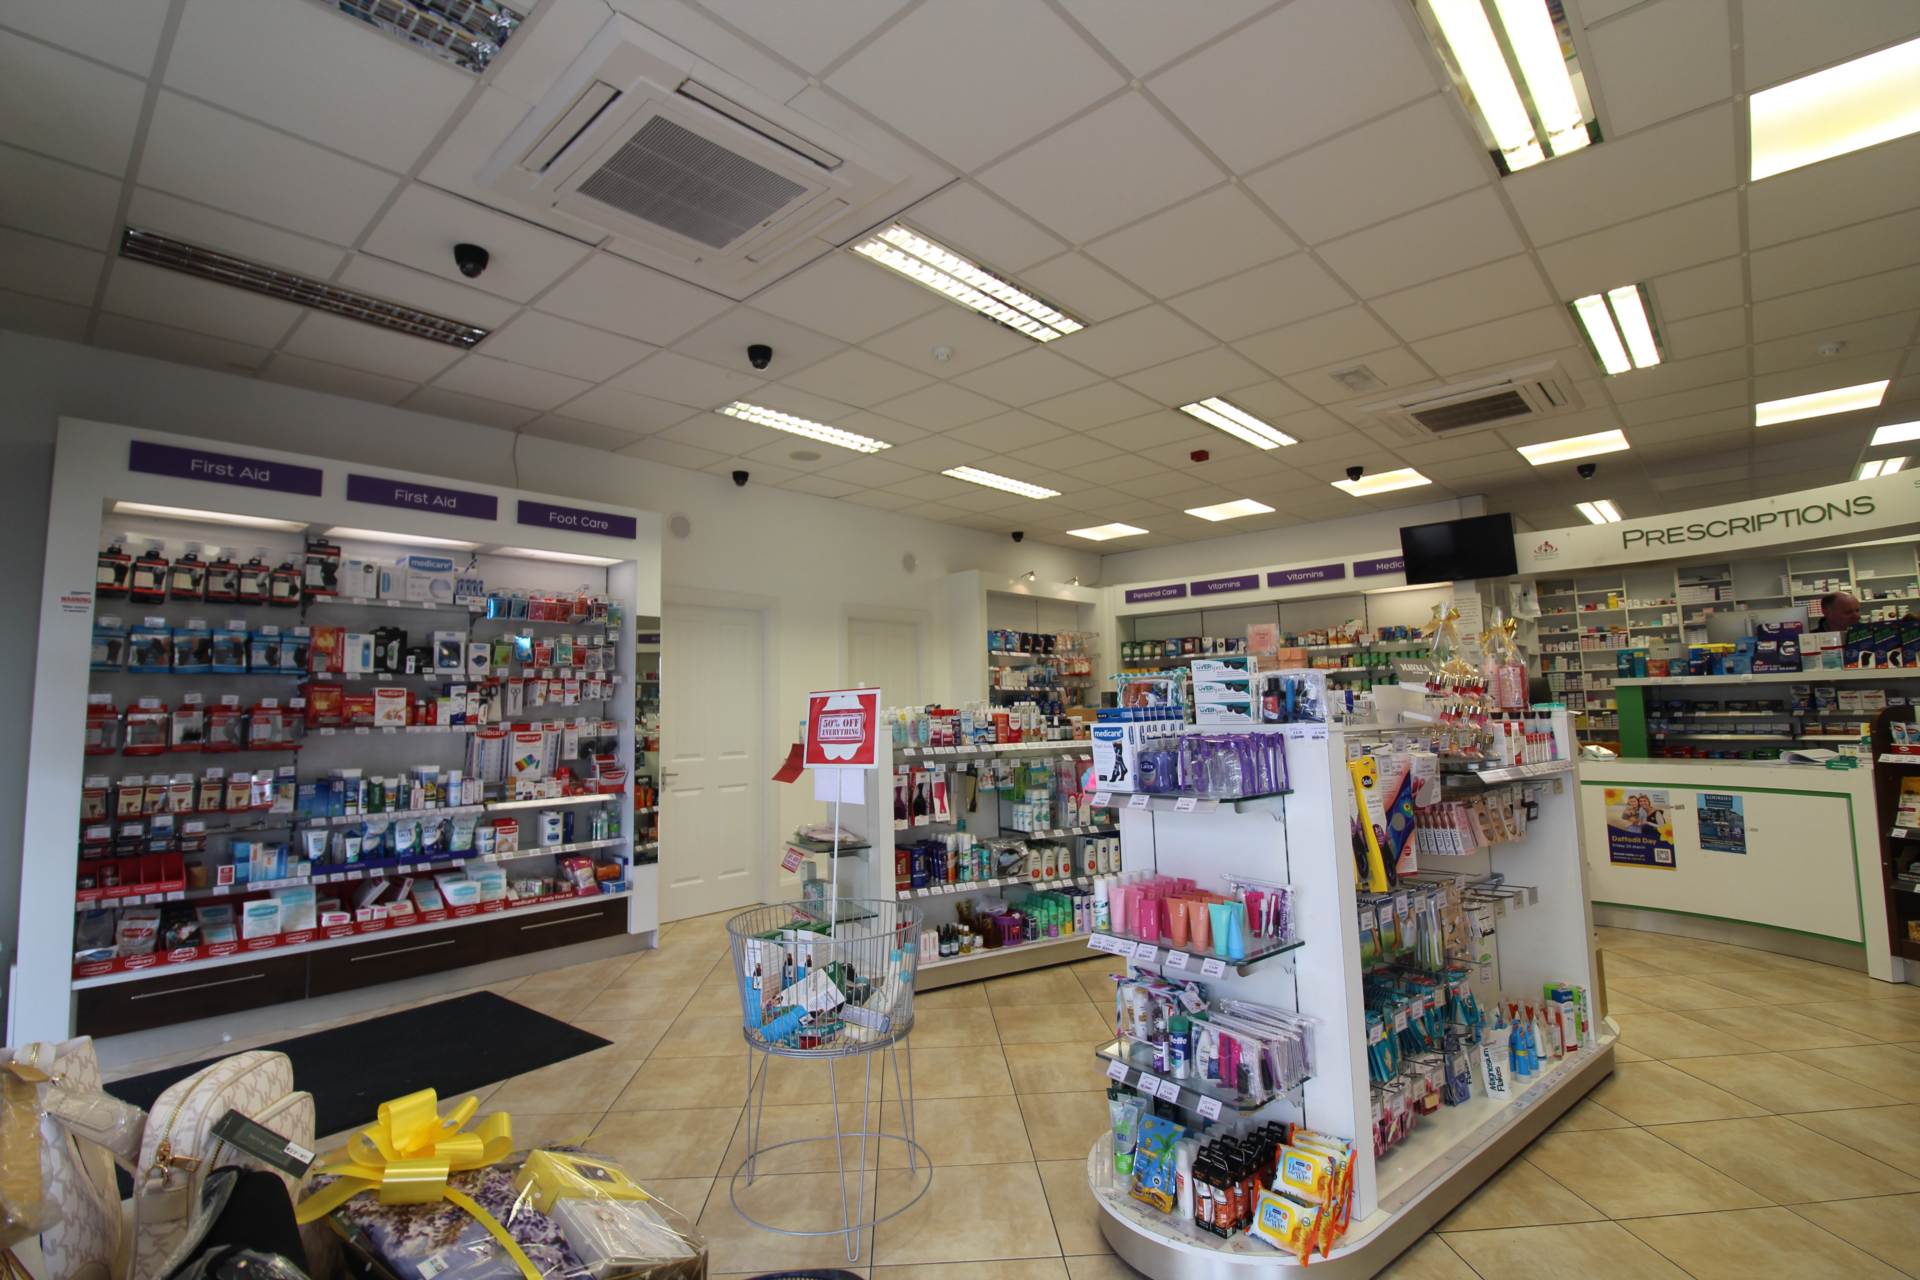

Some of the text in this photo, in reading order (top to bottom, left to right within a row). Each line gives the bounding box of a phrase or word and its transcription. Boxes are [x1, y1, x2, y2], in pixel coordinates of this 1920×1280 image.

[190, 459, 270, 481] First Aid
[395, 489, 457, 509] First Aid
[549, 512, 609, 530] Foot Care
[1286, 569, 1324, 582] Vitamins
[1207, 580, 1241, 591] Vitamins
[1133, 588, 1177, 599] Personal Care
[823, 718, 859, 728] 50% OFF
[821, 727, 859, 736] EVERYTHING
[1095, 729, 1120, 738] medicare
[1642, 837, 1656, 846] Day
[1495, 1066, 1505, 1093] Flakes
